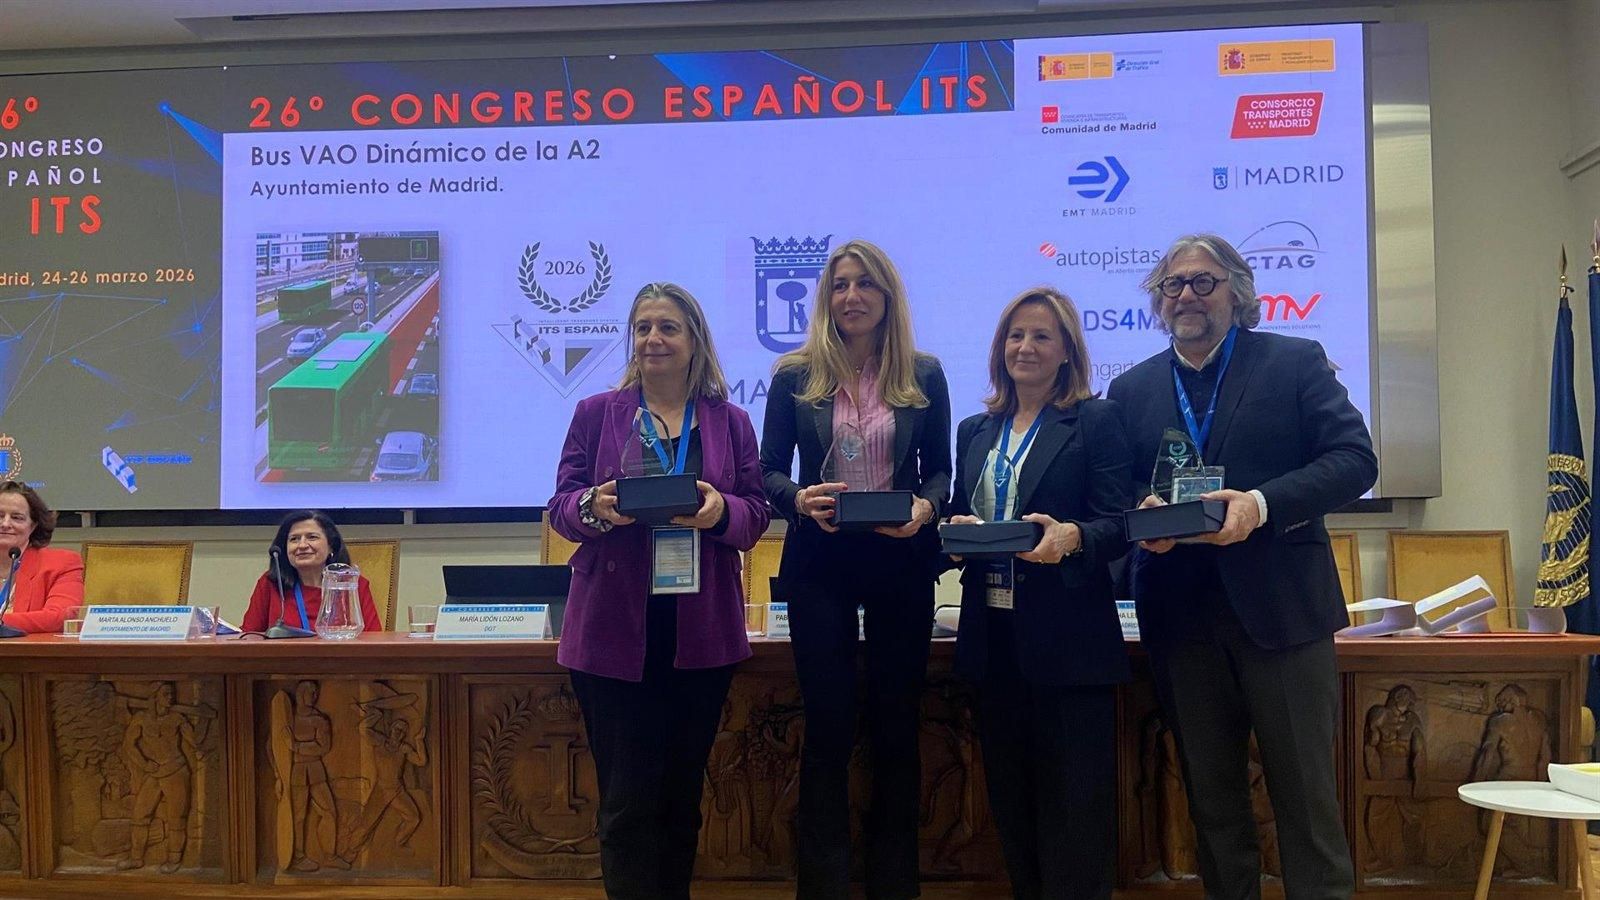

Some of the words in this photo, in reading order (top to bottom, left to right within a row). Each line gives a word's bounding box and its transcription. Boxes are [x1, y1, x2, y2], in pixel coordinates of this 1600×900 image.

[351, 87, 634, 126] CONGRESO
[664, 76, 892, 118] ESPAÑOL
[921, 75, 987, 109] ITS
[1250, 98, 1316, 109] CONSORCIO
[1243, 108, 1313, 120] TRANSPORTES
[1041, 123, 1100, 134] Comunidad
[1104, 123, 1116, 132] de
[1120, 122, 1157, 131] Madrid
[1268, 118, 1311, 129] MADRID
[251, 146, 291, 166] Bus
[300, 144, 357, 165] VAO
[367, 141, 486, 164] Dinámico
[495, 139, 528, 161] de
[536, 139, 559, 160] la
[567, 139, 600, 160] A2
[1245, 165, 1344, 186] MADRID
[250, 178, 389, 199] Ayuntamiento
[397, 178, 422, 194] de
[429, 177, 504, 193] Madrid.
[31, 195, 102, 235] ITS
[1062, 208, 1085, 217] EMT
[1091, 207, 1136, 216] MADRID
[1056, 247, 1160, 270] autopistas
[1246, 255, 1316, 270] CTAG
[545, 260, 586, 276] 2026
[42, 271, 88, 285] 24-26
[96, 271, 148, 284] marzo
[156, 269, 195, 282] 2026
[539, 326, 560, 334] ITS
[564, 323, 619, 334] ESPAÑA
